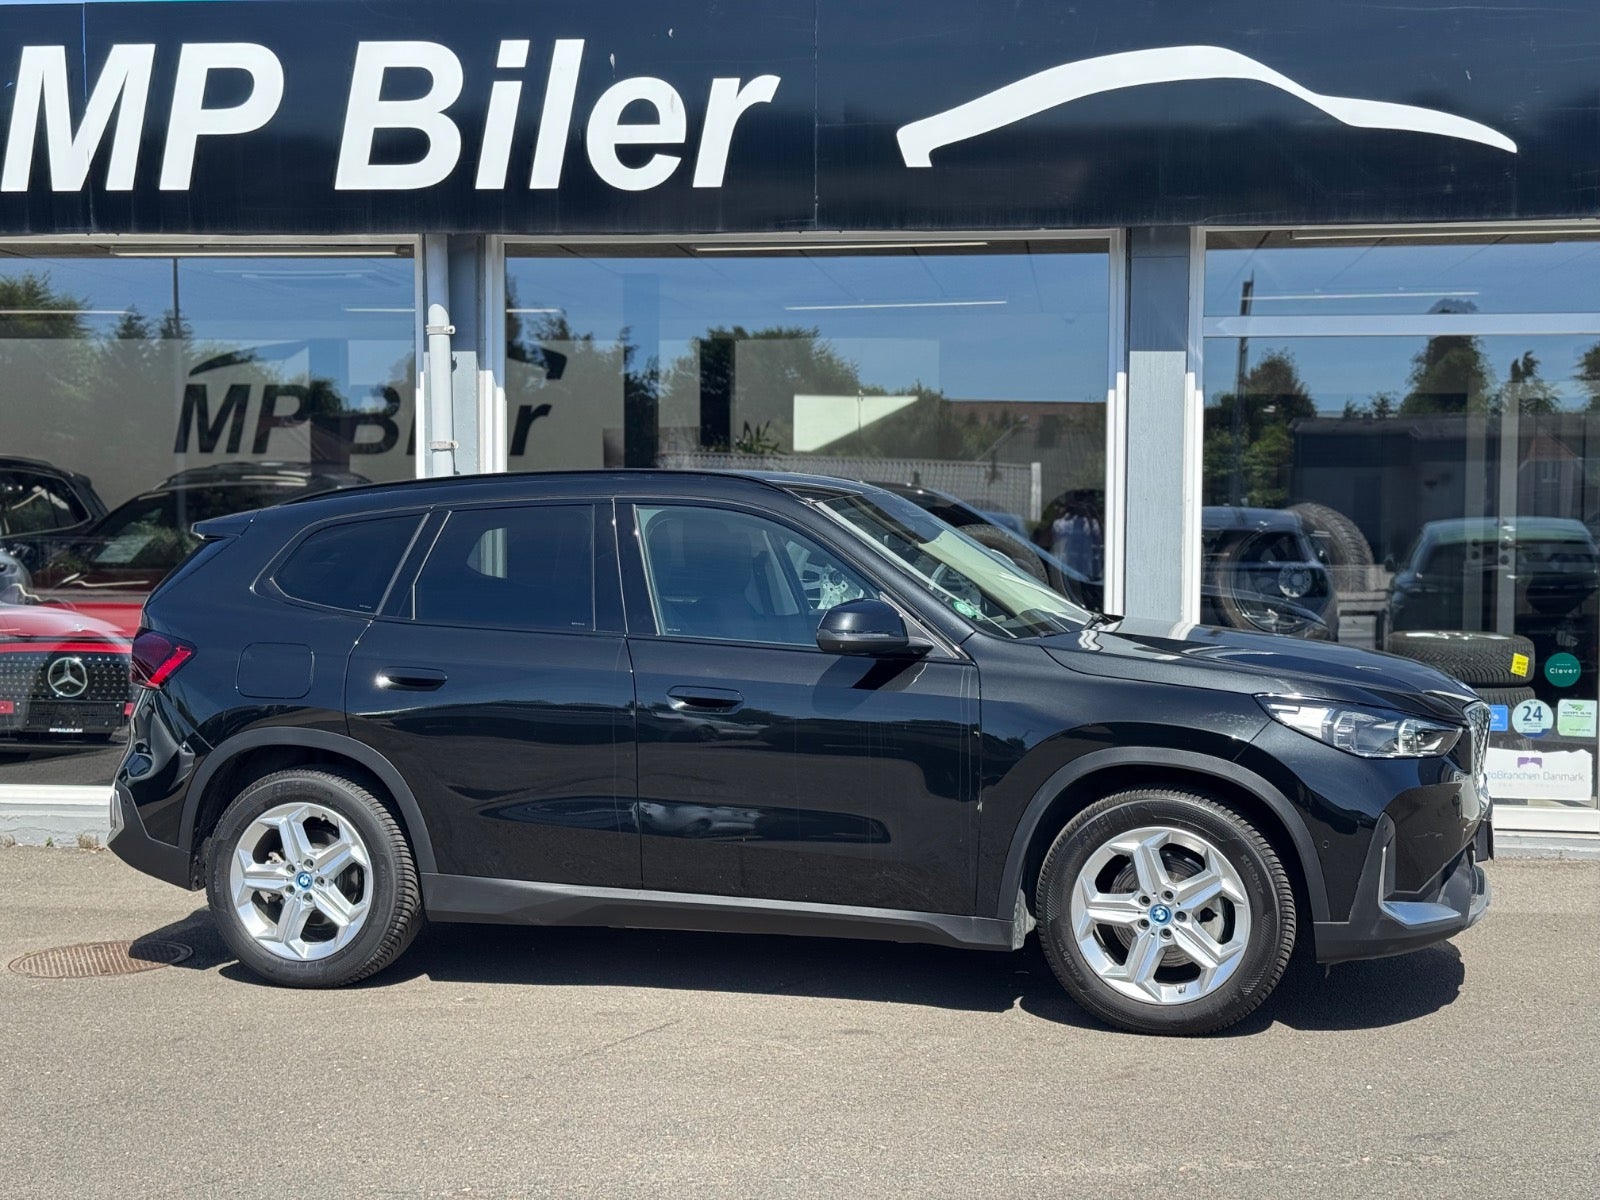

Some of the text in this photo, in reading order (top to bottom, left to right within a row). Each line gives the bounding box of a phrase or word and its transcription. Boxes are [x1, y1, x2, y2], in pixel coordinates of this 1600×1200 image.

[1, 39, 781, 191] MP Biler
[1522, 705, 1543, 722] 24
[1488, 769, 1540, 781] toBranchen
